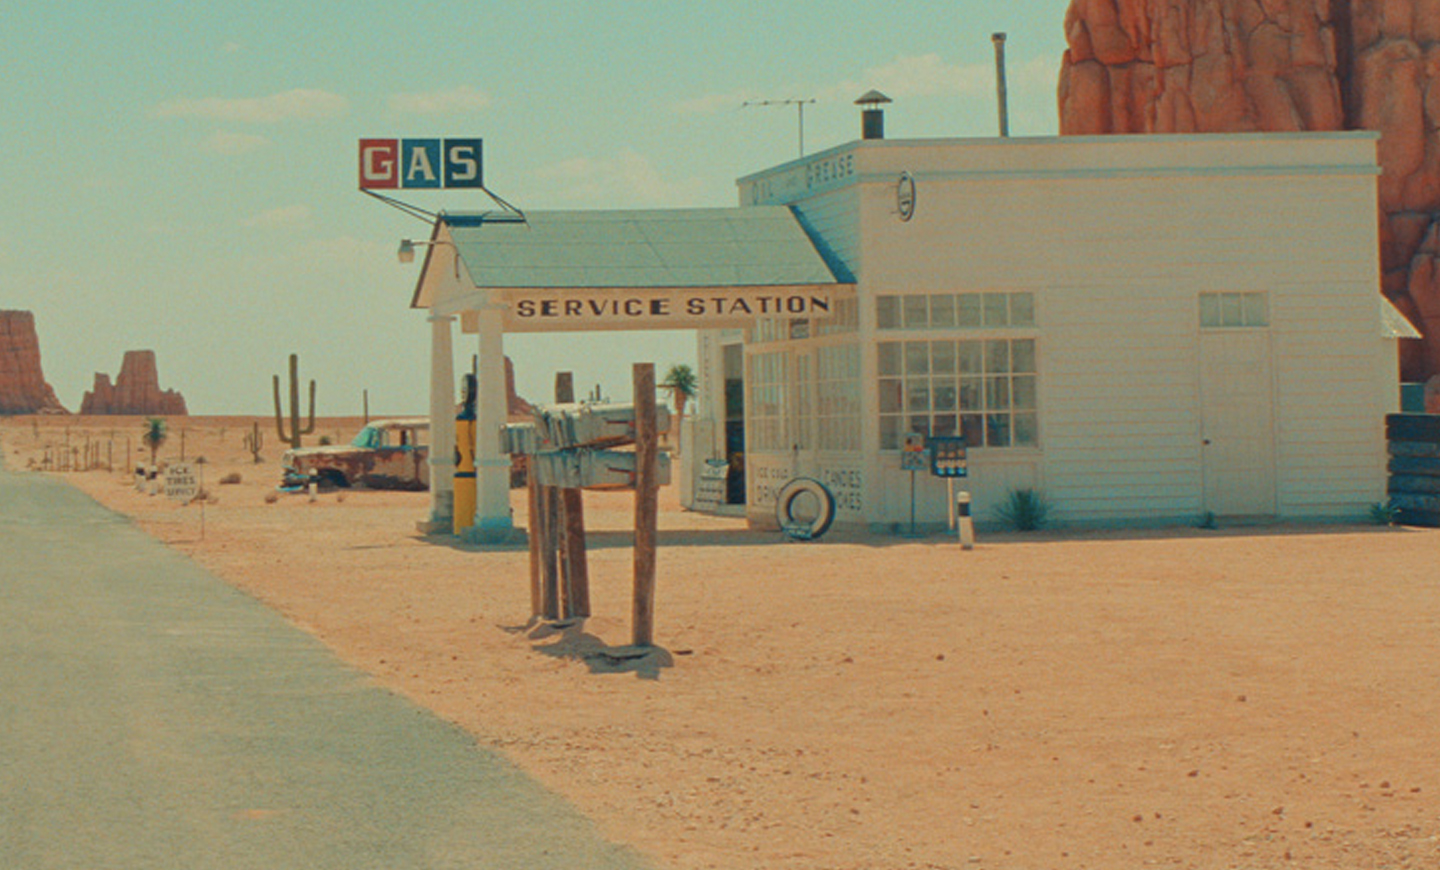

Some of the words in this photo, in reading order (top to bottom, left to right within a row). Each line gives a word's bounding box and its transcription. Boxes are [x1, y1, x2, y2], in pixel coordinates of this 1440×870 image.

[363, 146, 477, 180] GAS
[805, 154, 854, 189] GREASE
[516, 298, 671, 317] SERVICE
[686, 295, 830, 316] STATION
